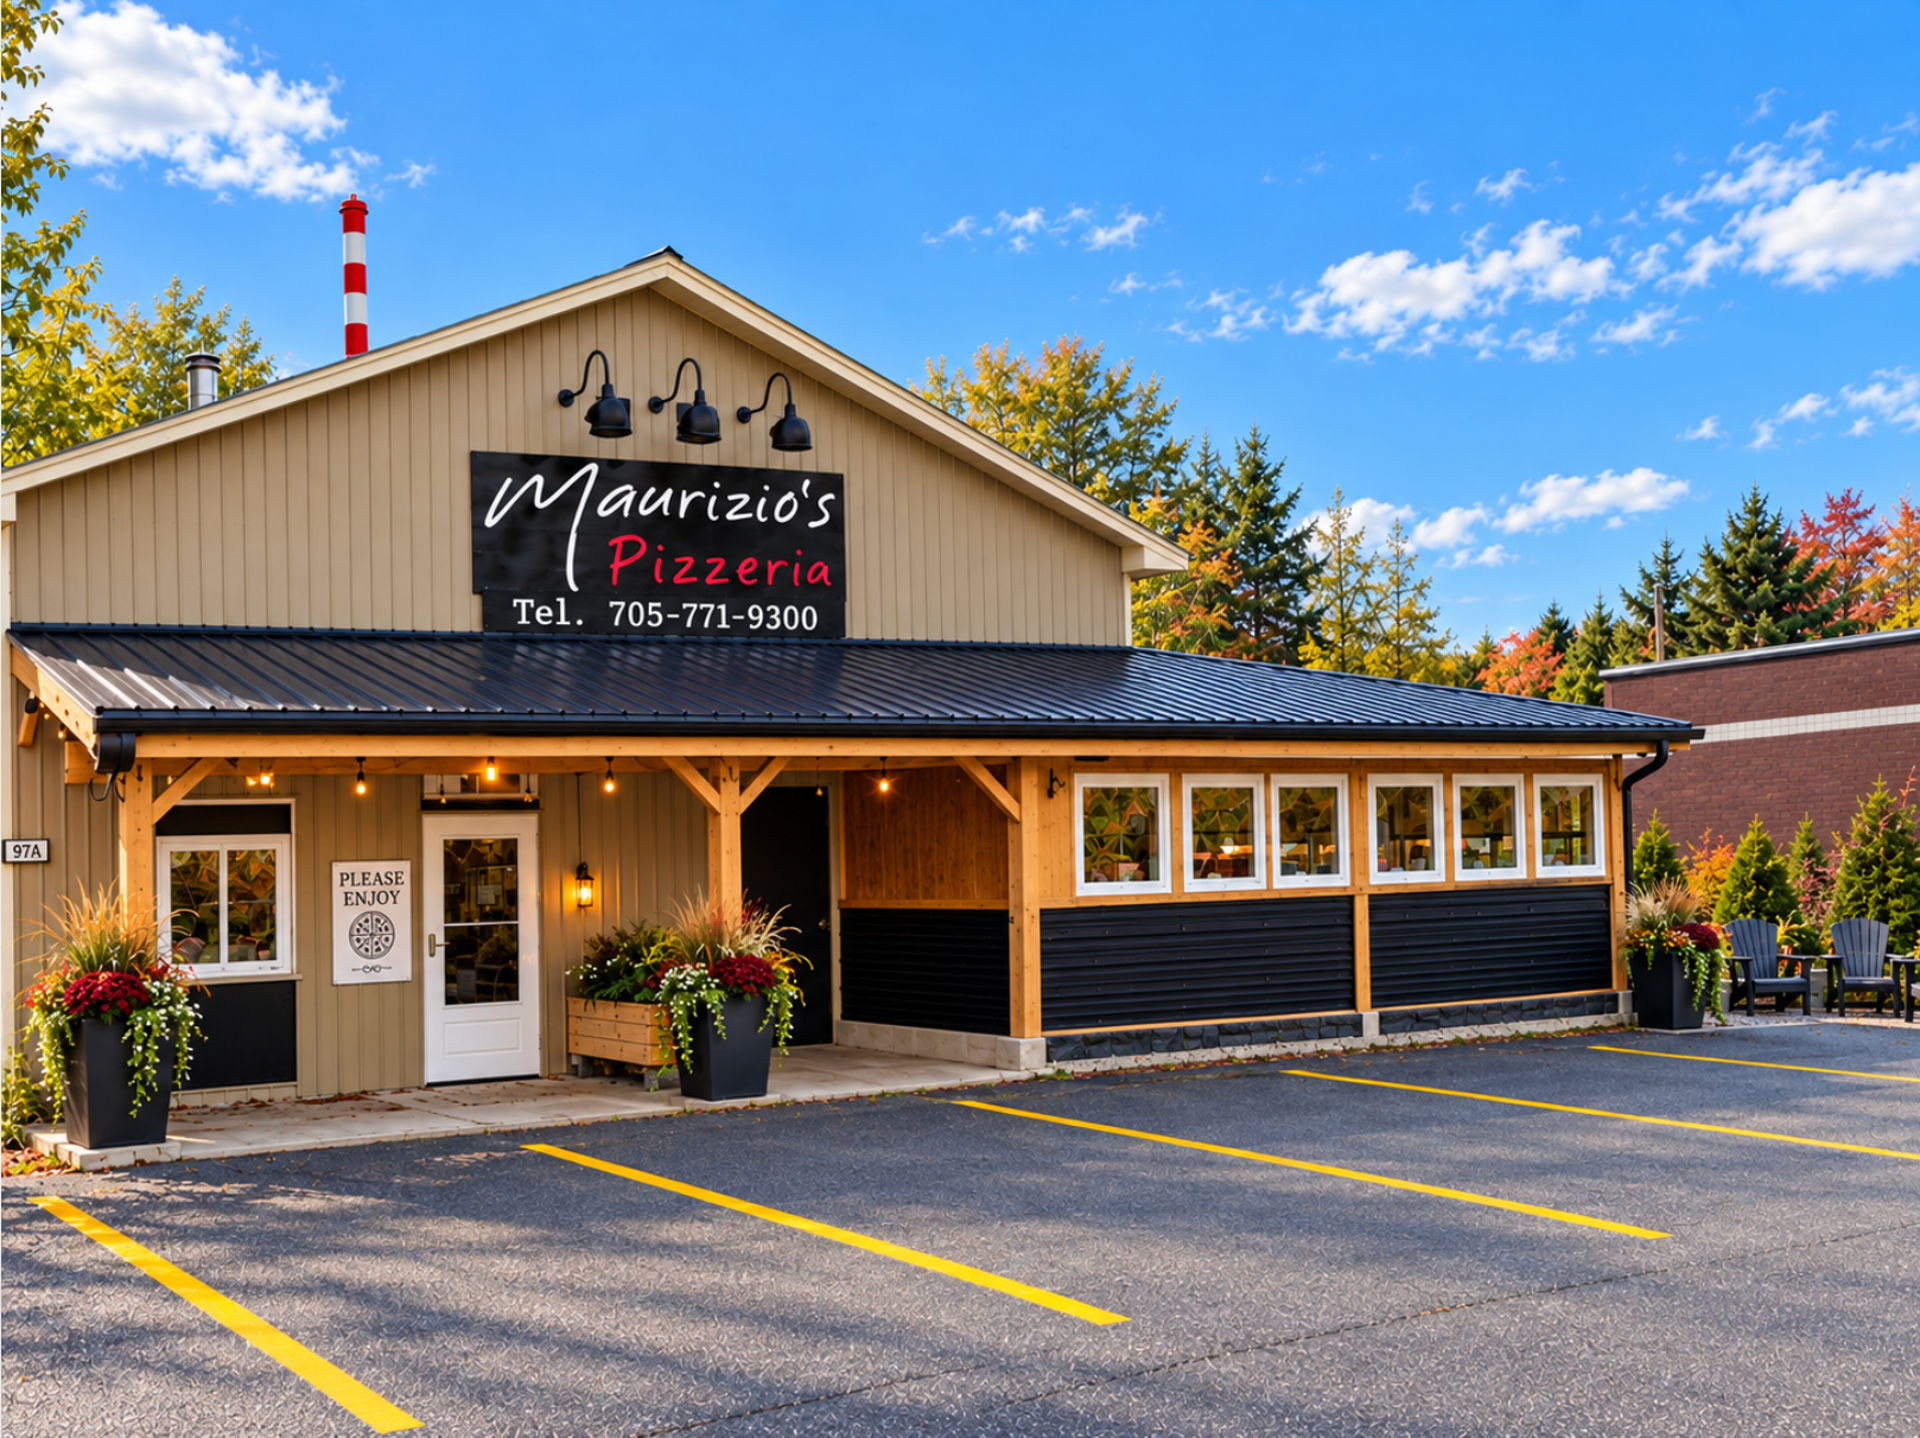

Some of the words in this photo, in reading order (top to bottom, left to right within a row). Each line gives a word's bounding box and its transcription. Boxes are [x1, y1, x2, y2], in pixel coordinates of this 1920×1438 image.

[484, 462, 835, 592] Maurizio's
[608, 534, 832, 587] Pizzeria
[512, 598, 584, 626] Tel.
[609, 600, 818, 630] 705-771-9300
[12, 844, 42, 859] 97A
[339, 871, 405, 887] PLEASE
[343, 890, 400, 906] ENJOY
